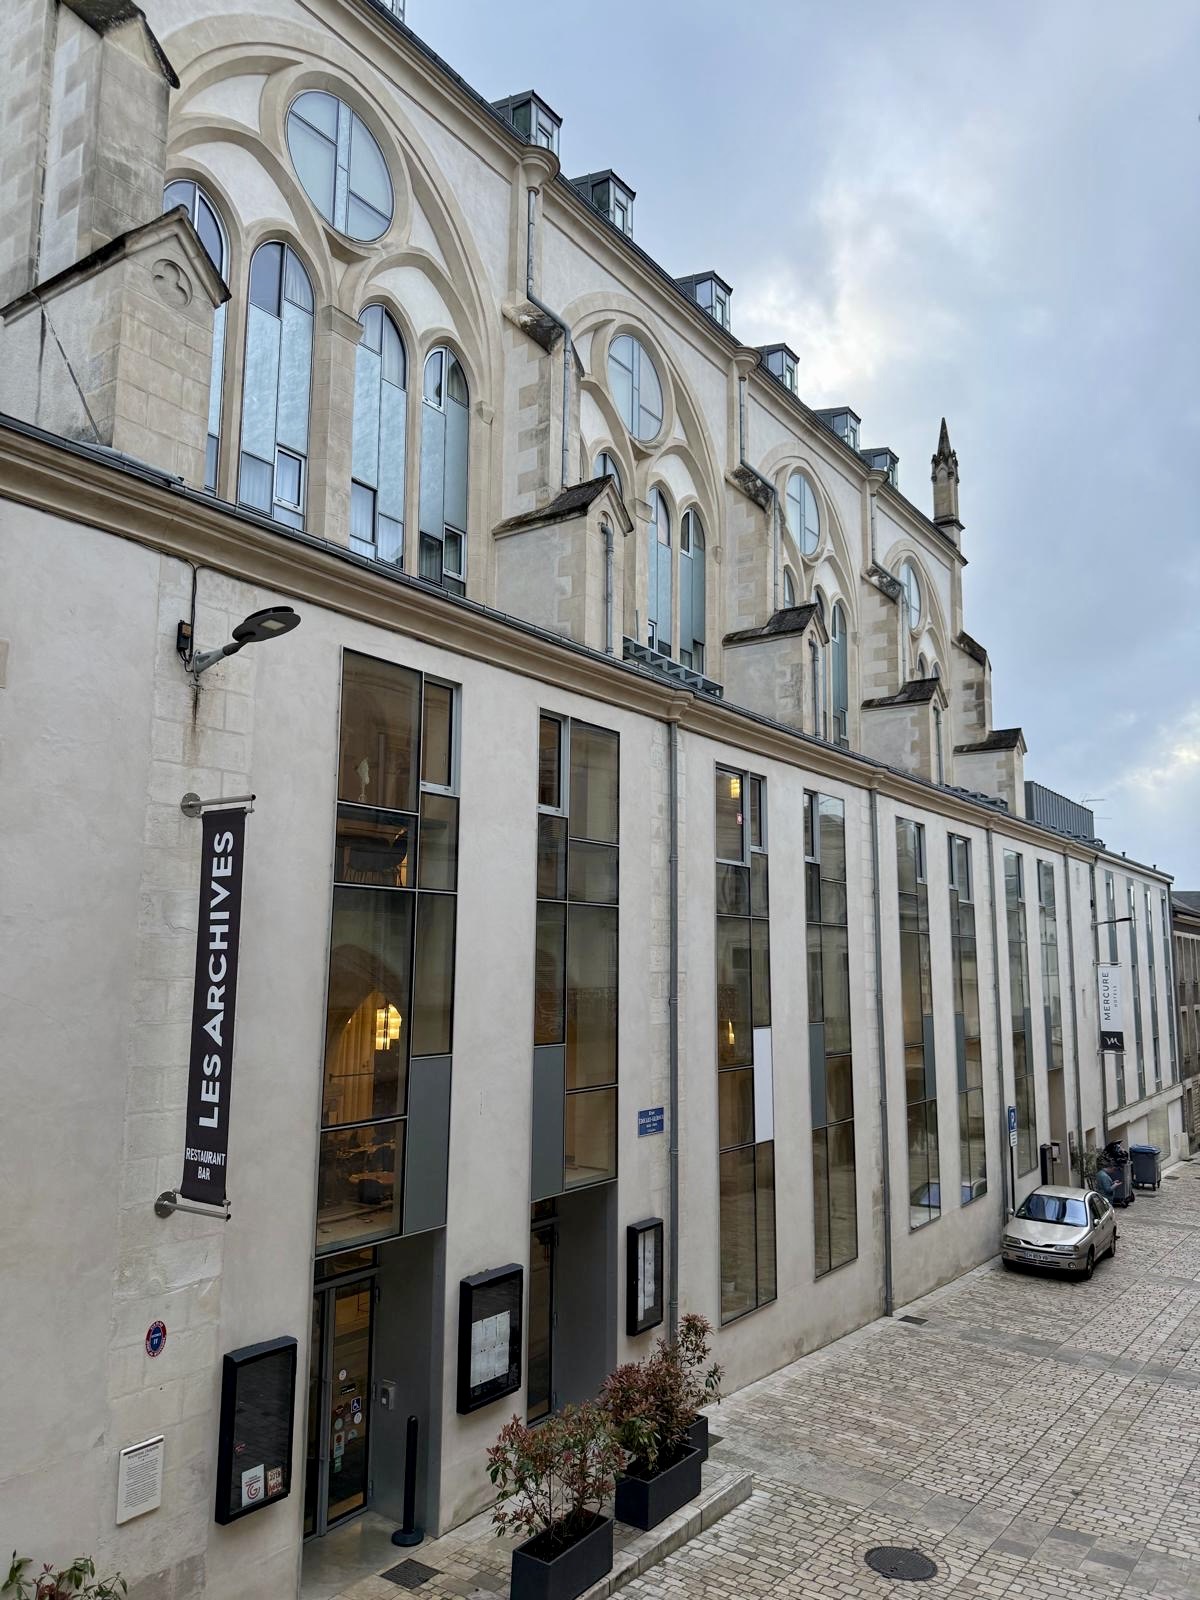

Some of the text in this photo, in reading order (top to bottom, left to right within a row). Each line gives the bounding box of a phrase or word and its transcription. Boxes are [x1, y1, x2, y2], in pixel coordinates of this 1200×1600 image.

[199, 830, 235, 1129] LES ARCHIVES
[1102, 972, 1111, 1020] MERCURE
[185, 1147, 226, 1166] RESTAURANT
[197, 1166, 211, 1181] BAR
